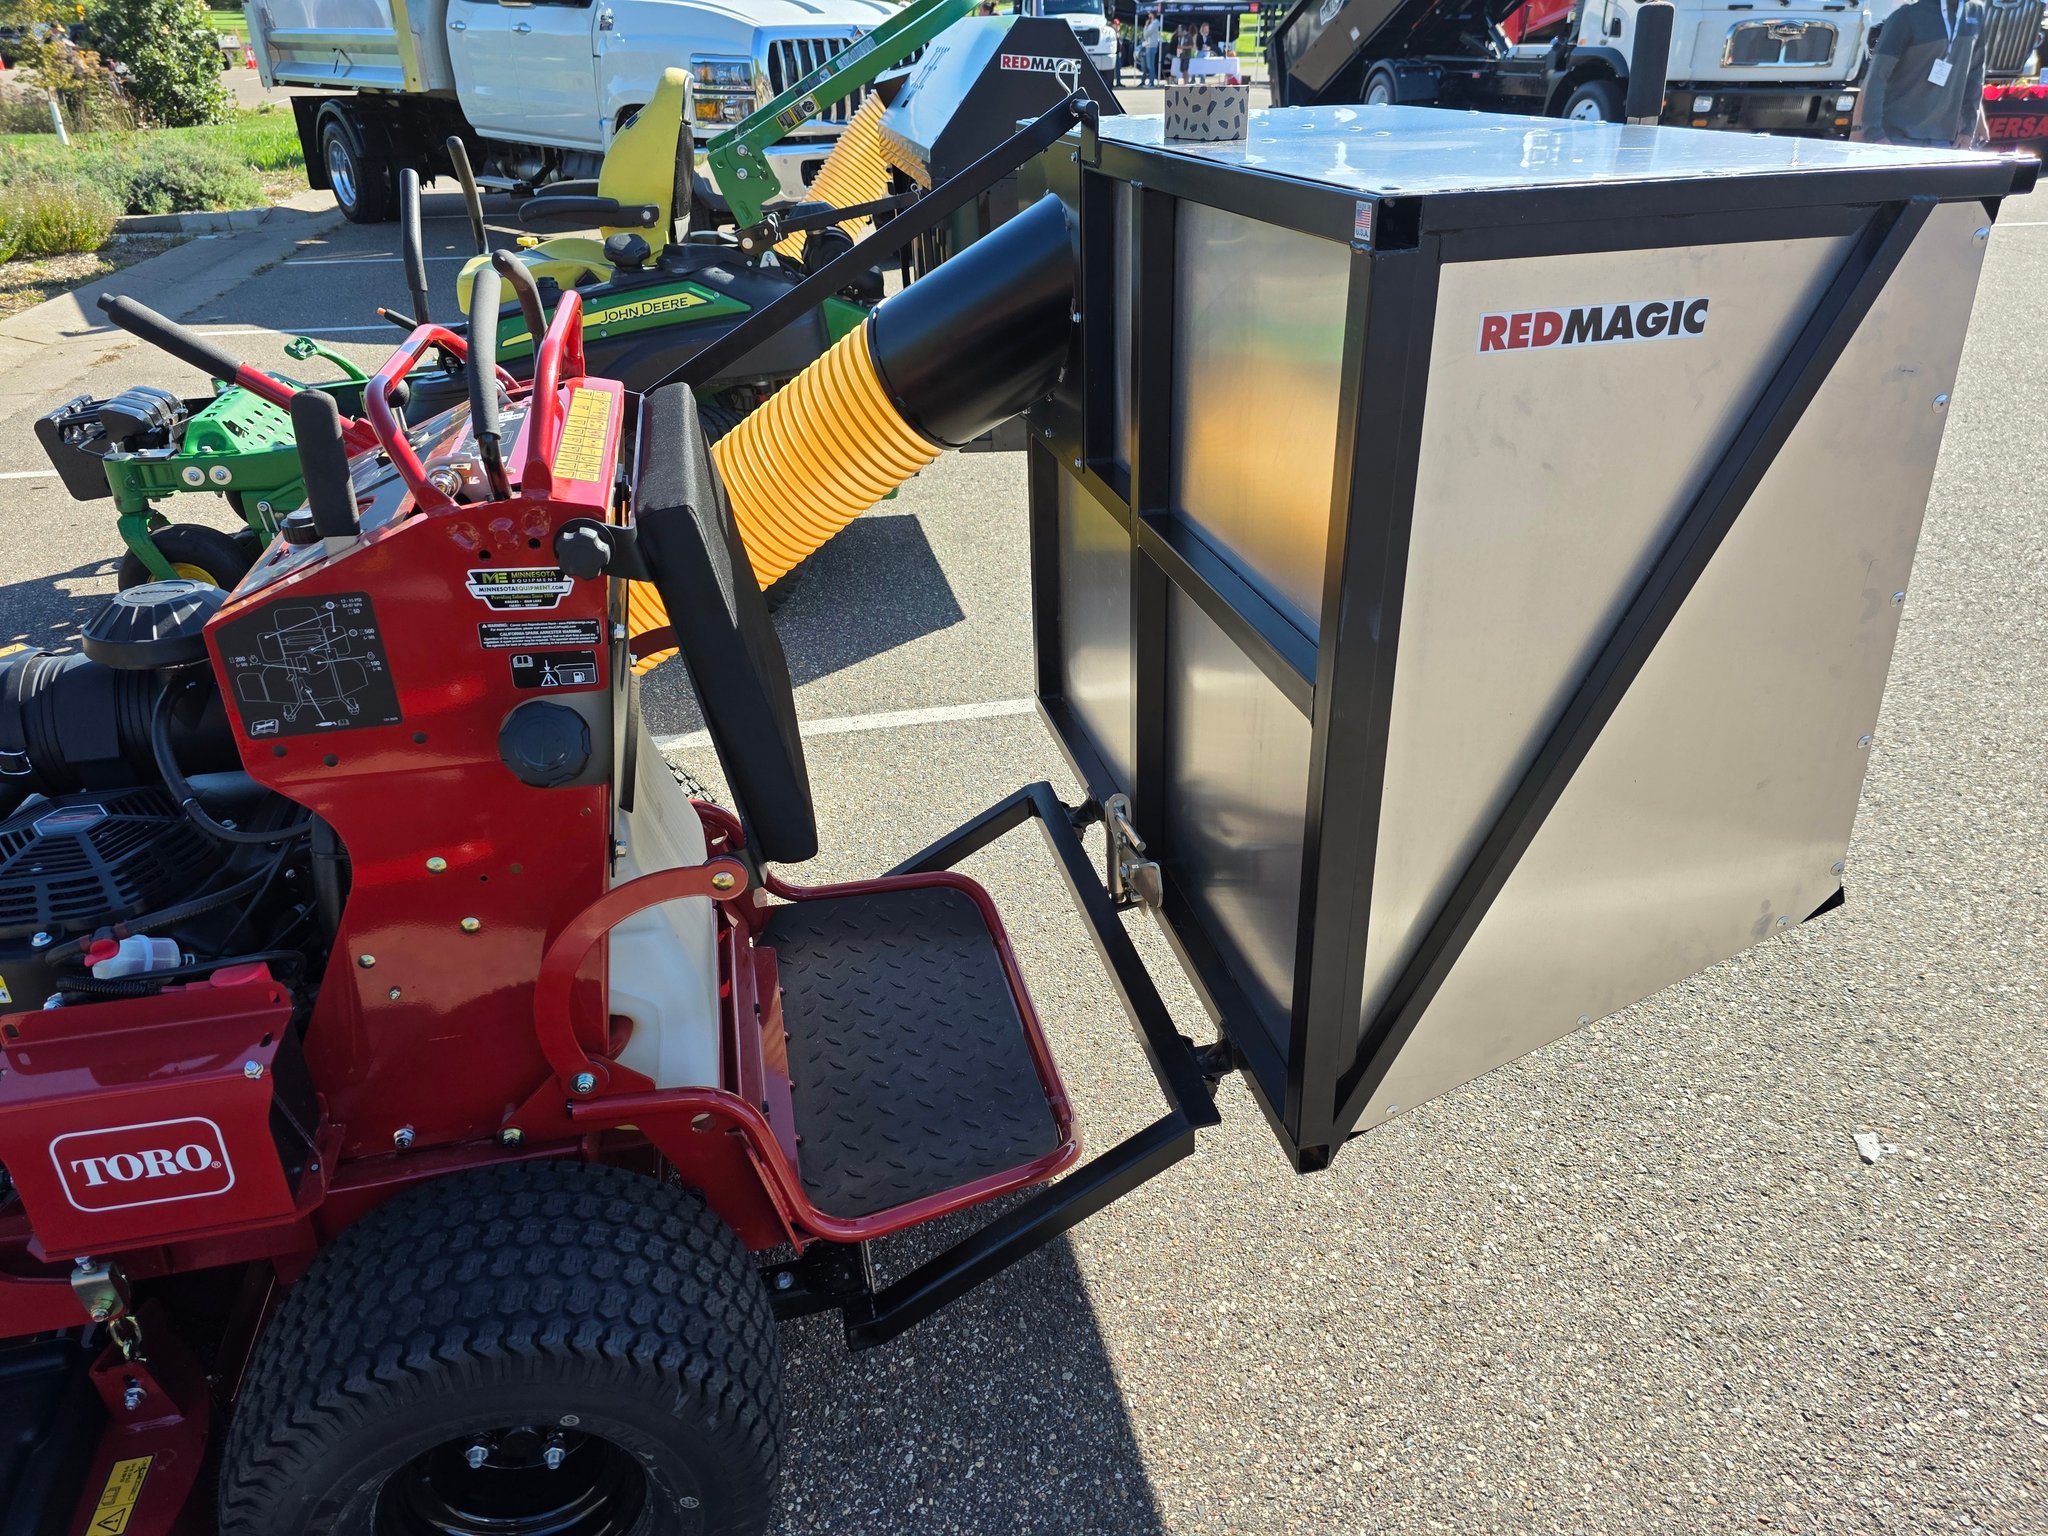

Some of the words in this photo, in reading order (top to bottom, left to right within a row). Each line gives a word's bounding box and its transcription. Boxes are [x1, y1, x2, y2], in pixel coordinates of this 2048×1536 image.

[1987, 115, 2048, 138] ERSA
[600, 306, 638, 323] JOHN
[642, 297, 689, 314] DEERE
[1480, 299, 1709, 352] REDMAGIC
[71, 1144, 212, 1187] TORO
